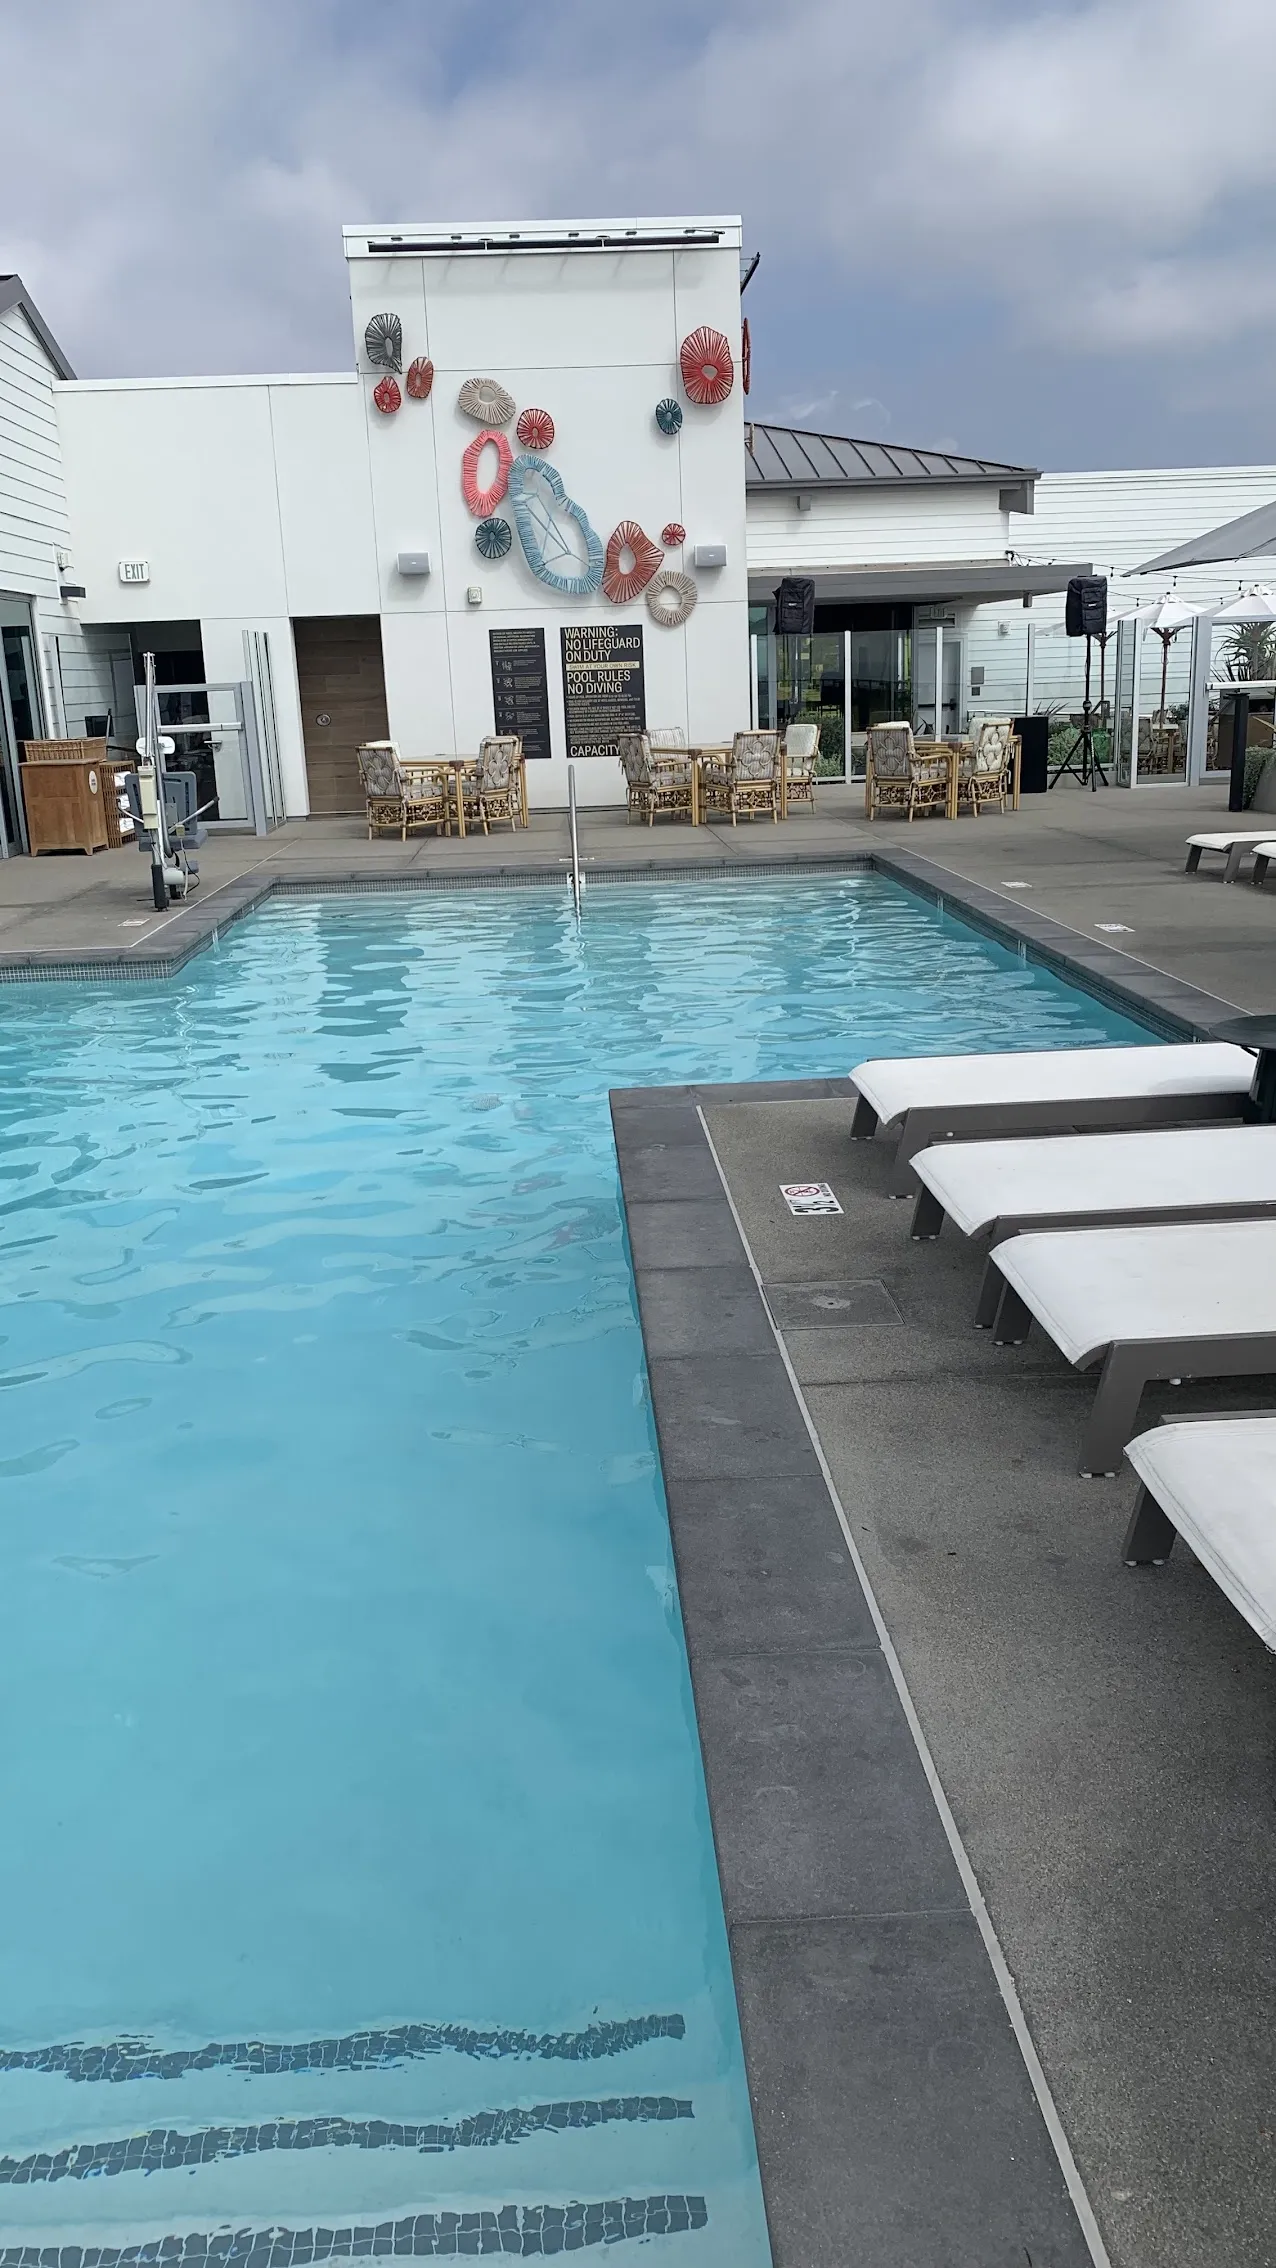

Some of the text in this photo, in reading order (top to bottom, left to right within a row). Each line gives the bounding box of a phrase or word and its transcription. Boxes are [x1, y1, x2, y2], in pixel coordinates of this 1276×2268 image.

[124, 563, 144, 580] EXIT
[564, 626, 619, 639] WARNING:
[565, 637, 641, 651] NO LIFEGUARD
[565, 649, 611, 662] ON DUTY
[566, 669, 631, 683] POOL RULES
[567, 681, 623, 695] NO DIVING
[570, 744, 620, 757] CAPACITY
